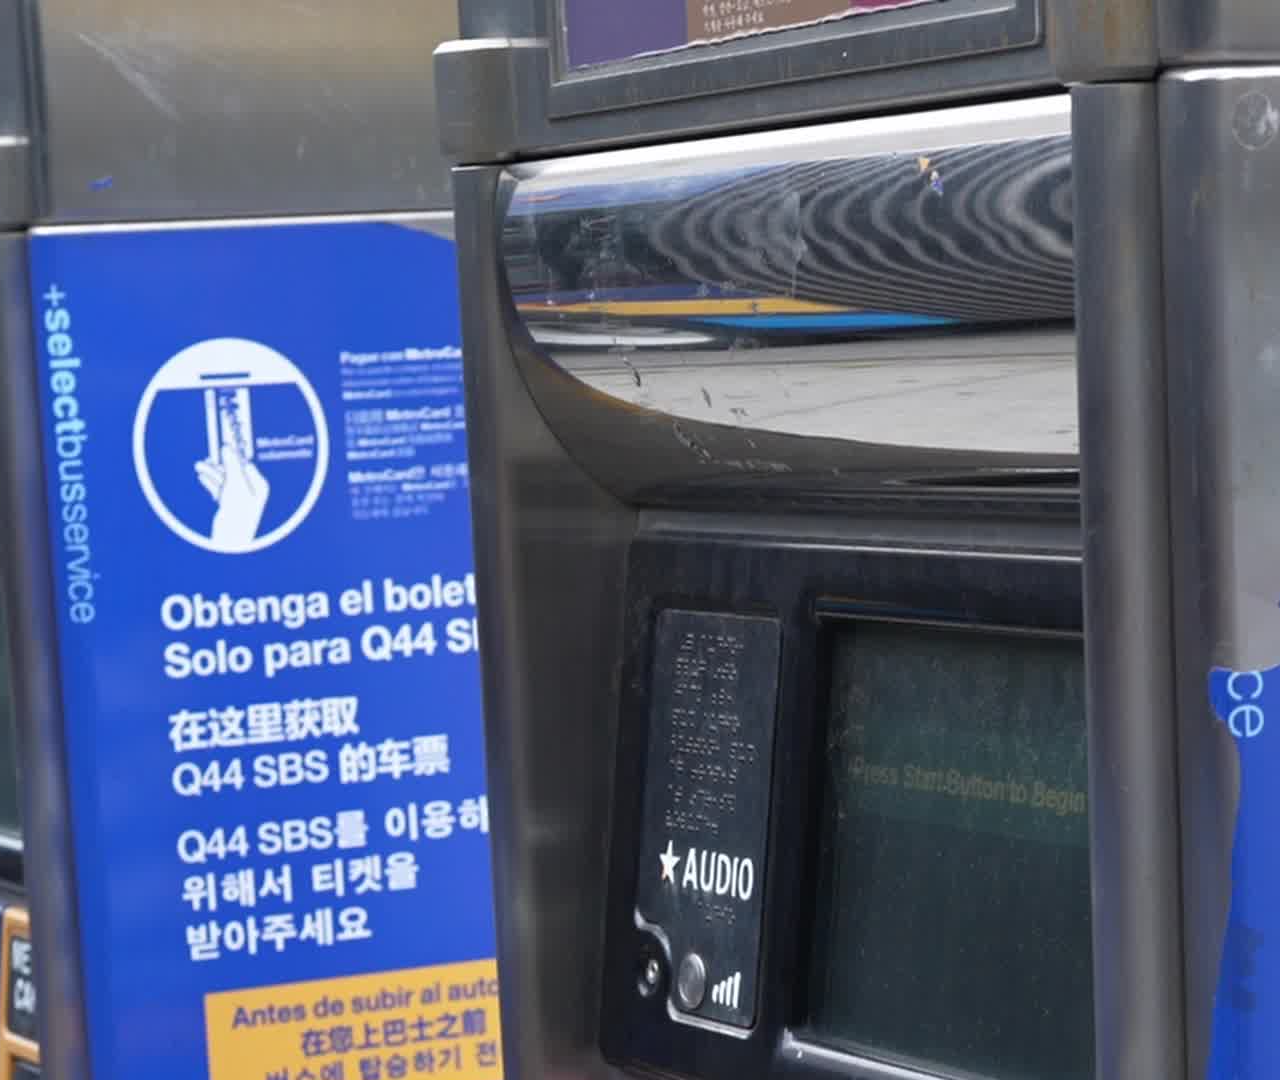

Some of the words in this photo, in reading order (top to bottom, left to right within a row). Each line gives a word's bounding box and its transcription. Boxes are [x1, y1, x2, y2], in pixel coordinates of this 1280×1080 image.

[161, 590, 330, 632] Obtenga
[339, 579, 373, 615] el
[383, 571, 477, 613] bolet
[164, 637, 253, 679] Solo
[263, 635, 352, 678] para
[361, 621, 437, 662] Q44
[168, 695, 360, 752] 在这里获取
[172, 758, 244, 797] Q44
[253, 749, 330, 788] SBS
[338, 733, 451, 785] 的车票
[177, 825, 250, 864] Q44
[384, 794, 490, 841] 이용하
[182, 863, 294, 912] 위해서
[311, 851, 419, 898] 티켓을
[682, 847, 755, 901] AUDIO
[185, 905, 373, 961] 받아주세요
[231, 1004, 307, 1030] Antes
[313, 995, 344, 1019] de
[351, 986, 414, 1014] subir
[420, 982, 441, 1005] al
[448, 978, 499, 1002] auto
